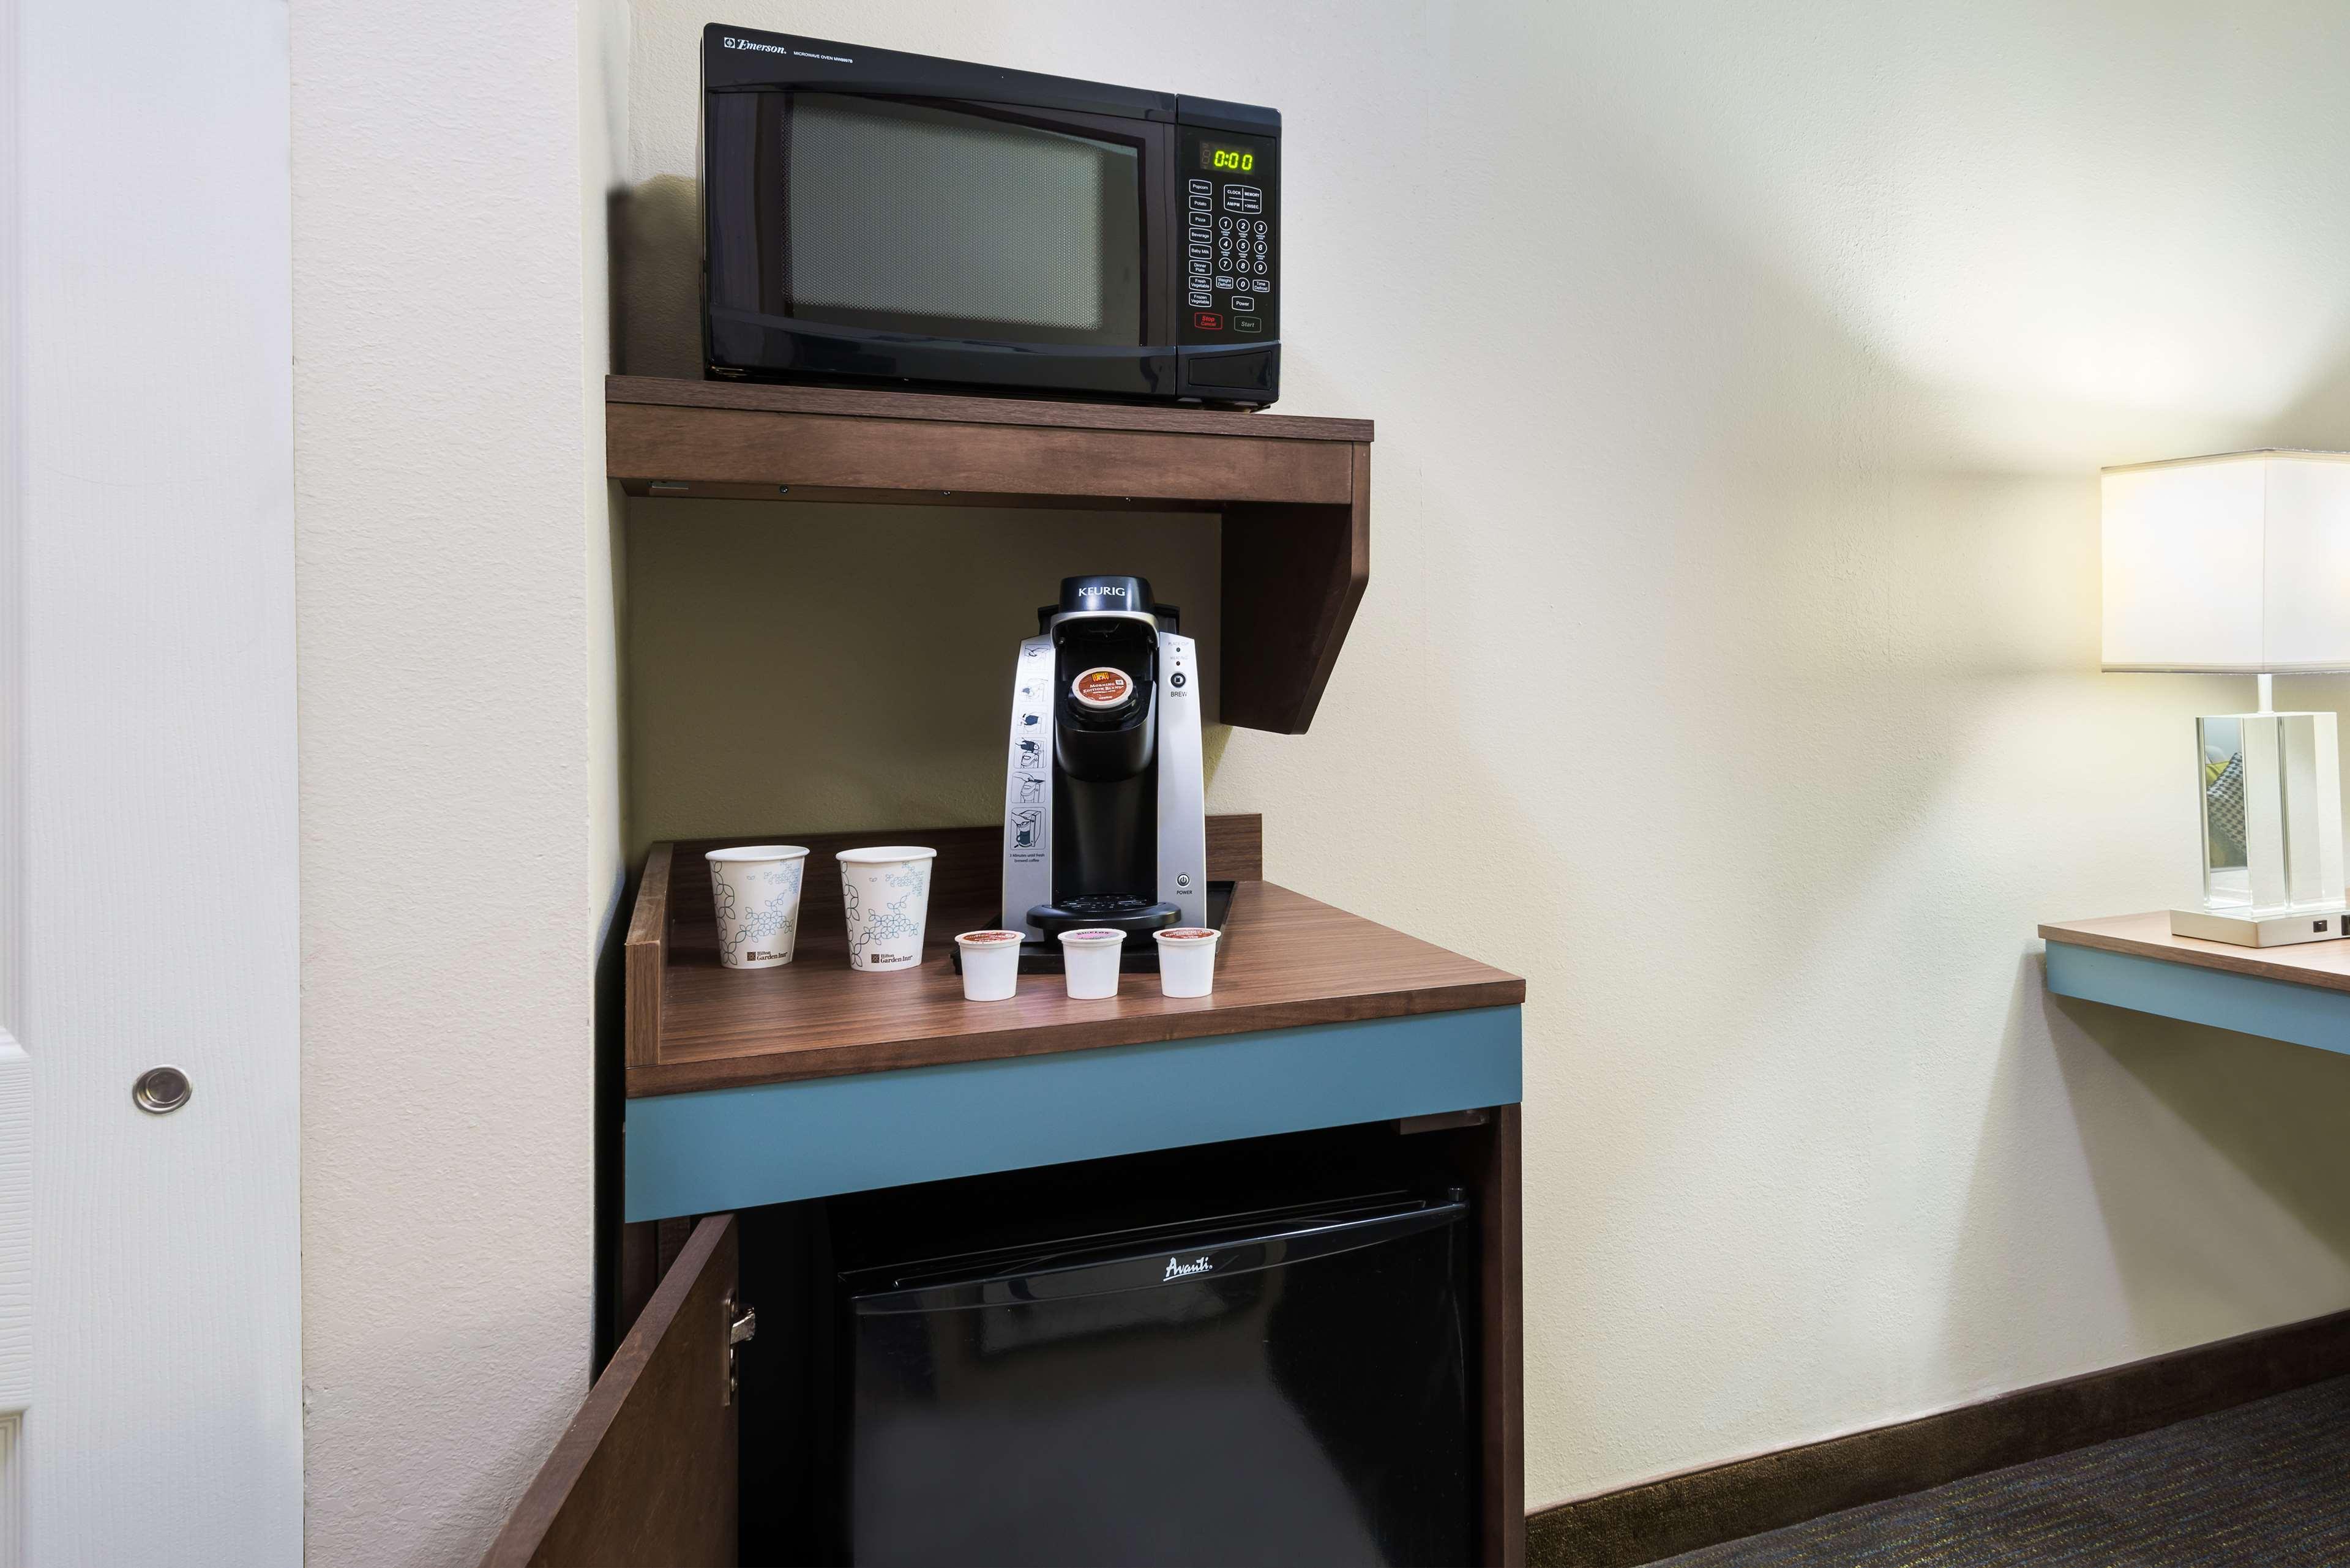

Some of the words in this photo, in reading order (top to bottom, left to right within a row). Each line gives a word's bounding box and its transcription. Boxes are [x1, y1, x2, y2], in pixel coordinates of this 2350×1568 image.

[1214, 150, 1253, 170] 0:00
[1079, 586, 1126, 597] KEURIG
[1166, 1256, 1209, 1278] Avanti
